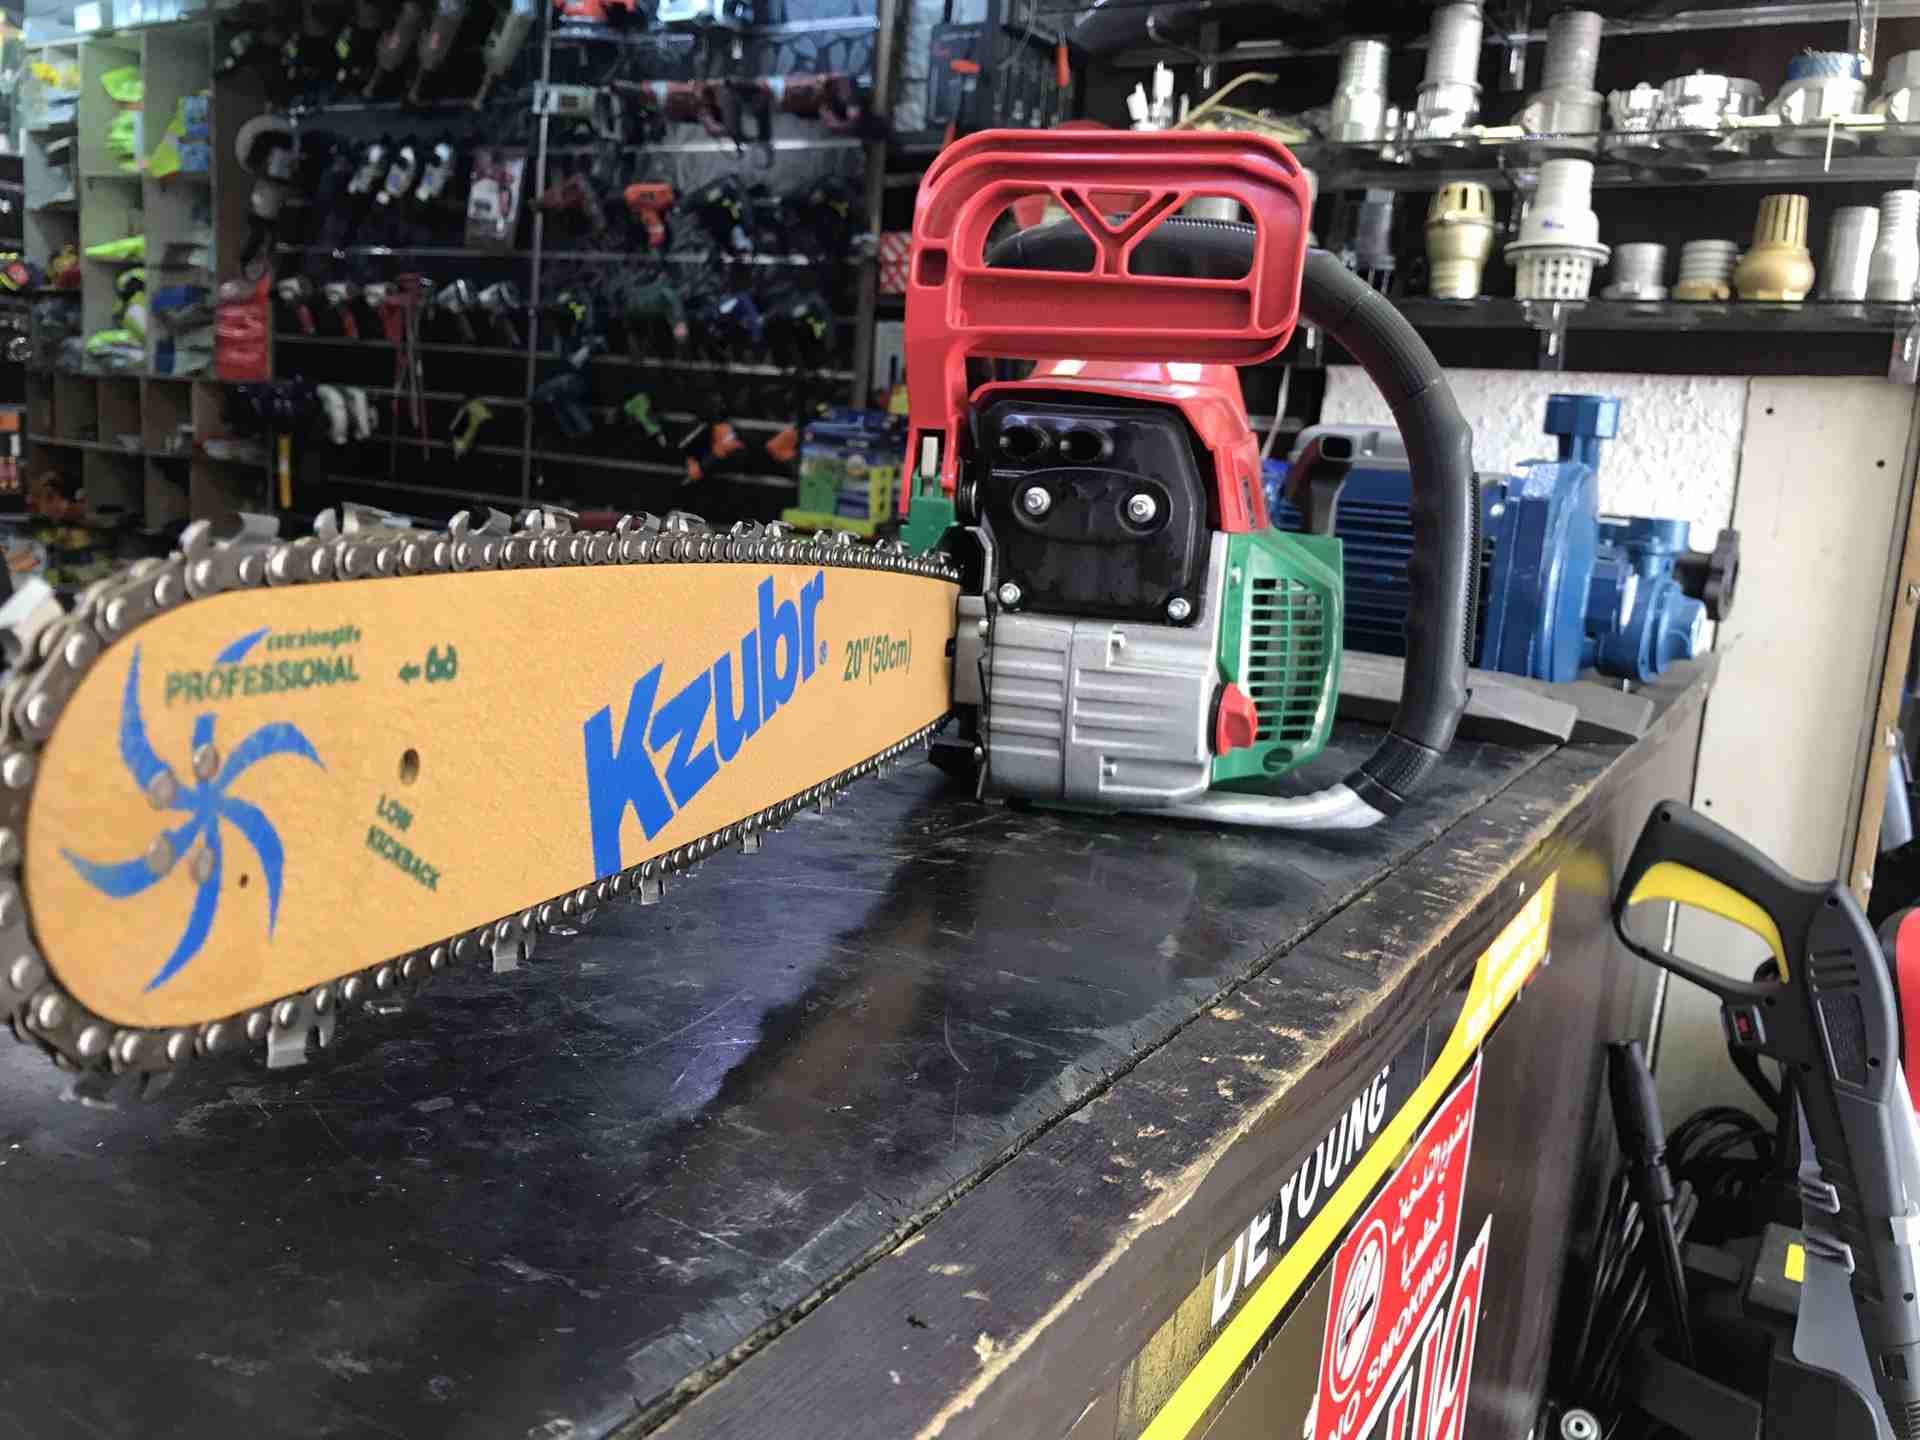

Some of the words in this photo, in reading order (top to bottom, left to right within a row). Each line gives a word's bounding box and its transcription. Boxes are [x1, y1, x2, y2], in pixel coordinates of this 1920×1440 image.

[164, 655, 358, 708] PROFESSIONAL
[583, 569, 824, 879] Kzubr
[376, 793, 414, 832] LOW
[366, 824, 441, 892] KICKBACK
[1365, 1239, 1448, 1398] SMOKING
